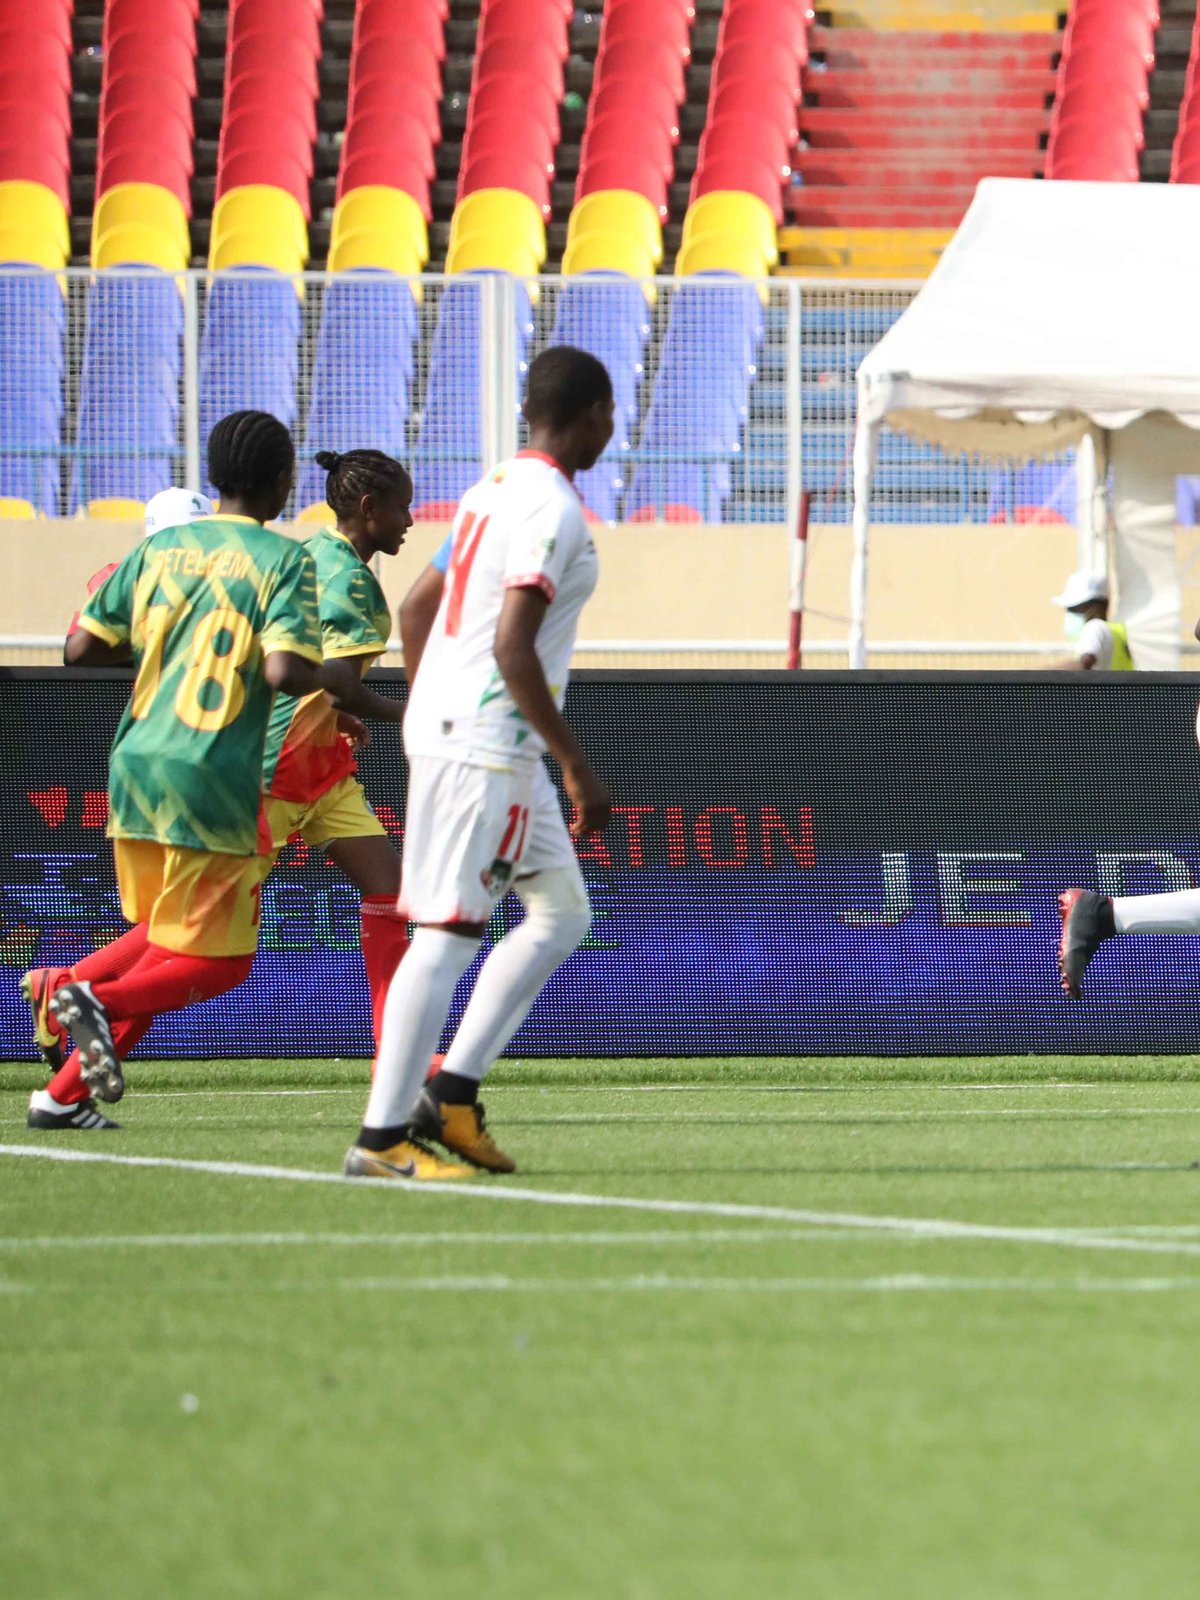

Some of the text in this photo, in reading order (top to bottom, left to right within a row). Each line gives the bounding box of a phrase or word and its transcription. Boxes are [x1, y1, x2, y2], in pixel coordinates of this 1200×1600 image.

[130, 604, 254, 732] 18
[496, 803, 529, 862] 11
[835, 850, 1033, 927] JE
